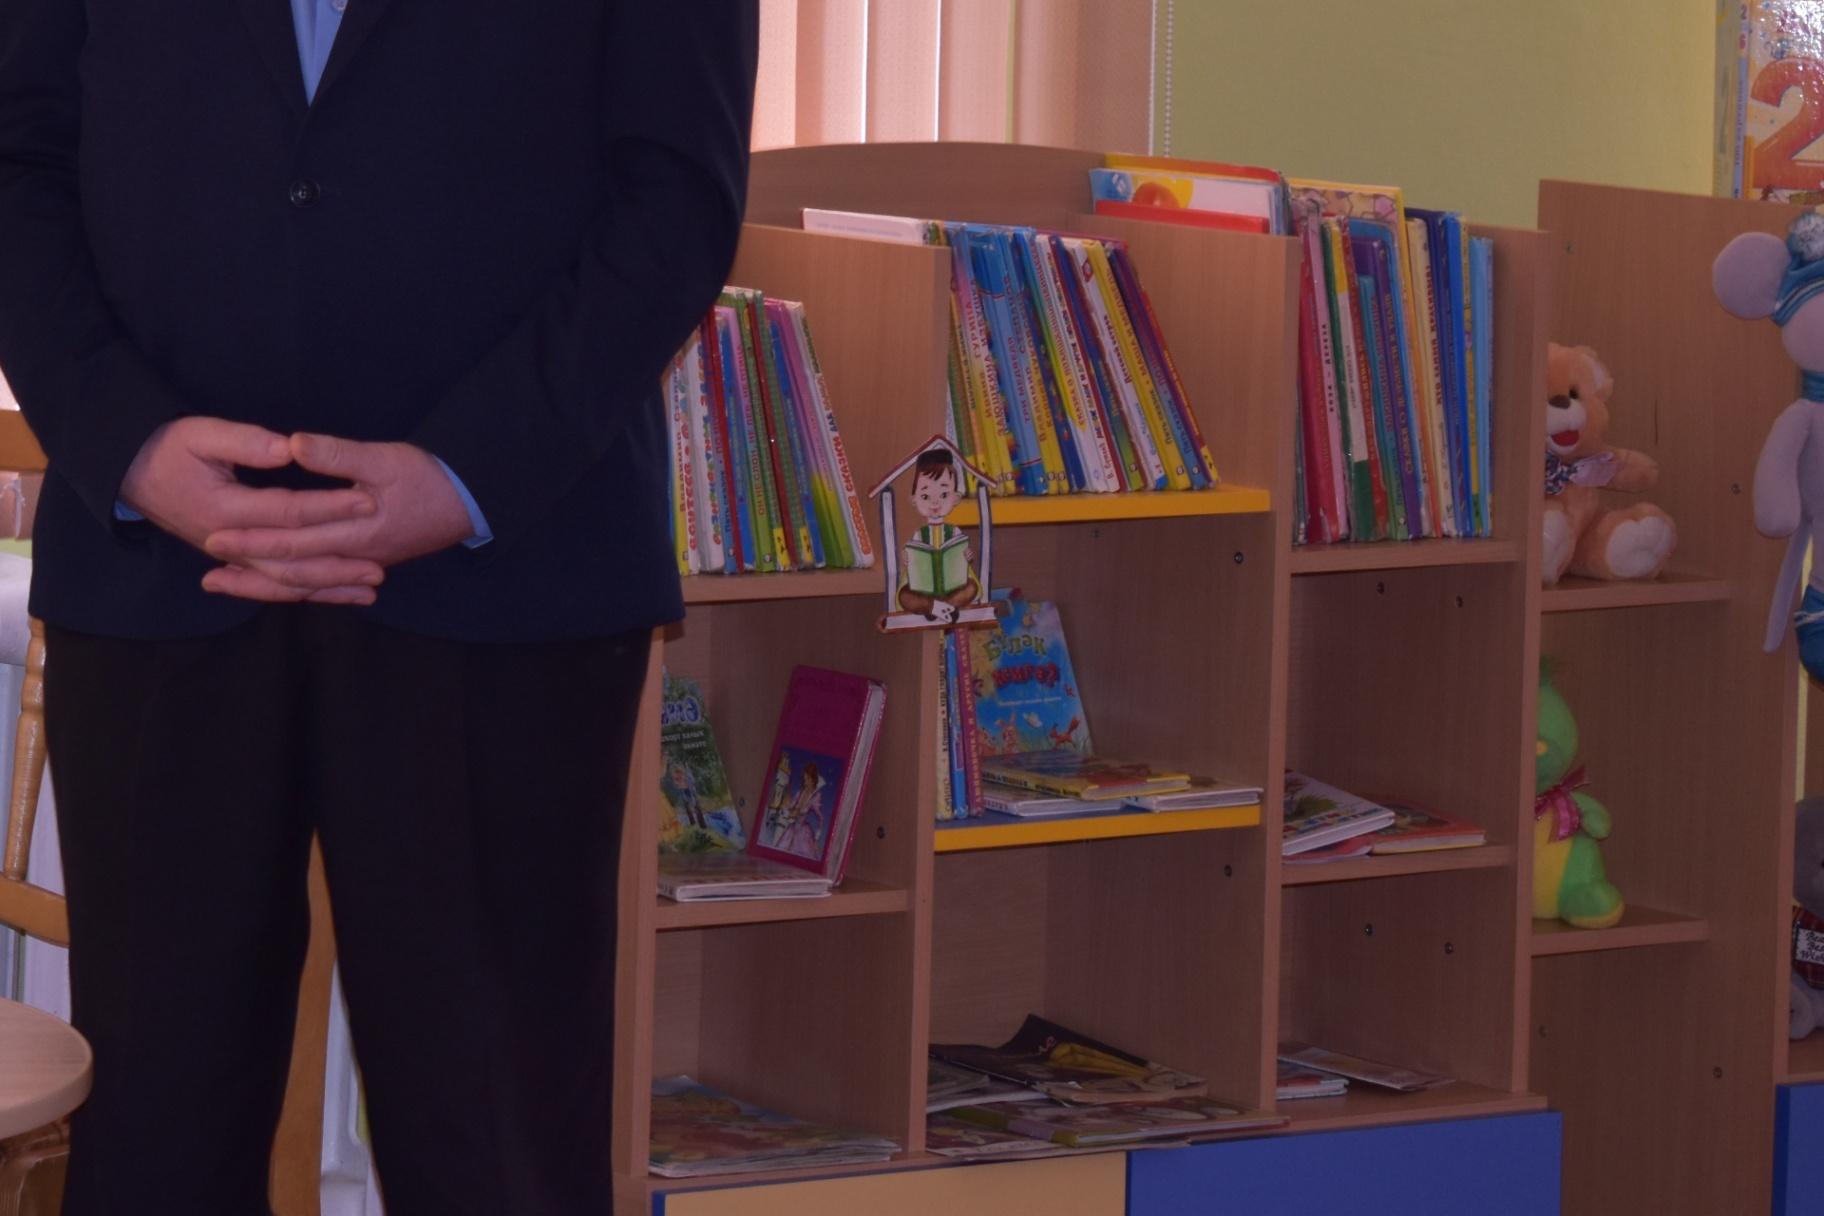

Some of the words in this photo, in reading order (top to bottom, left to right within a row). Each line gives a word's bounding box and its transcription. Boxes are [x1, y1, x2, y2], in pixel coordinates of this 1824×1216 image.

[1750, 57, 1824, 189] 2
[982, 354, 1006, 435] ЗАЮШКИНА
[1006, 336, 1025, 395] МЕДВЕДЯ
[1019, 397, 1031, 423] ТРИ
[831, 435, 852, 492] СКАЗКИ
